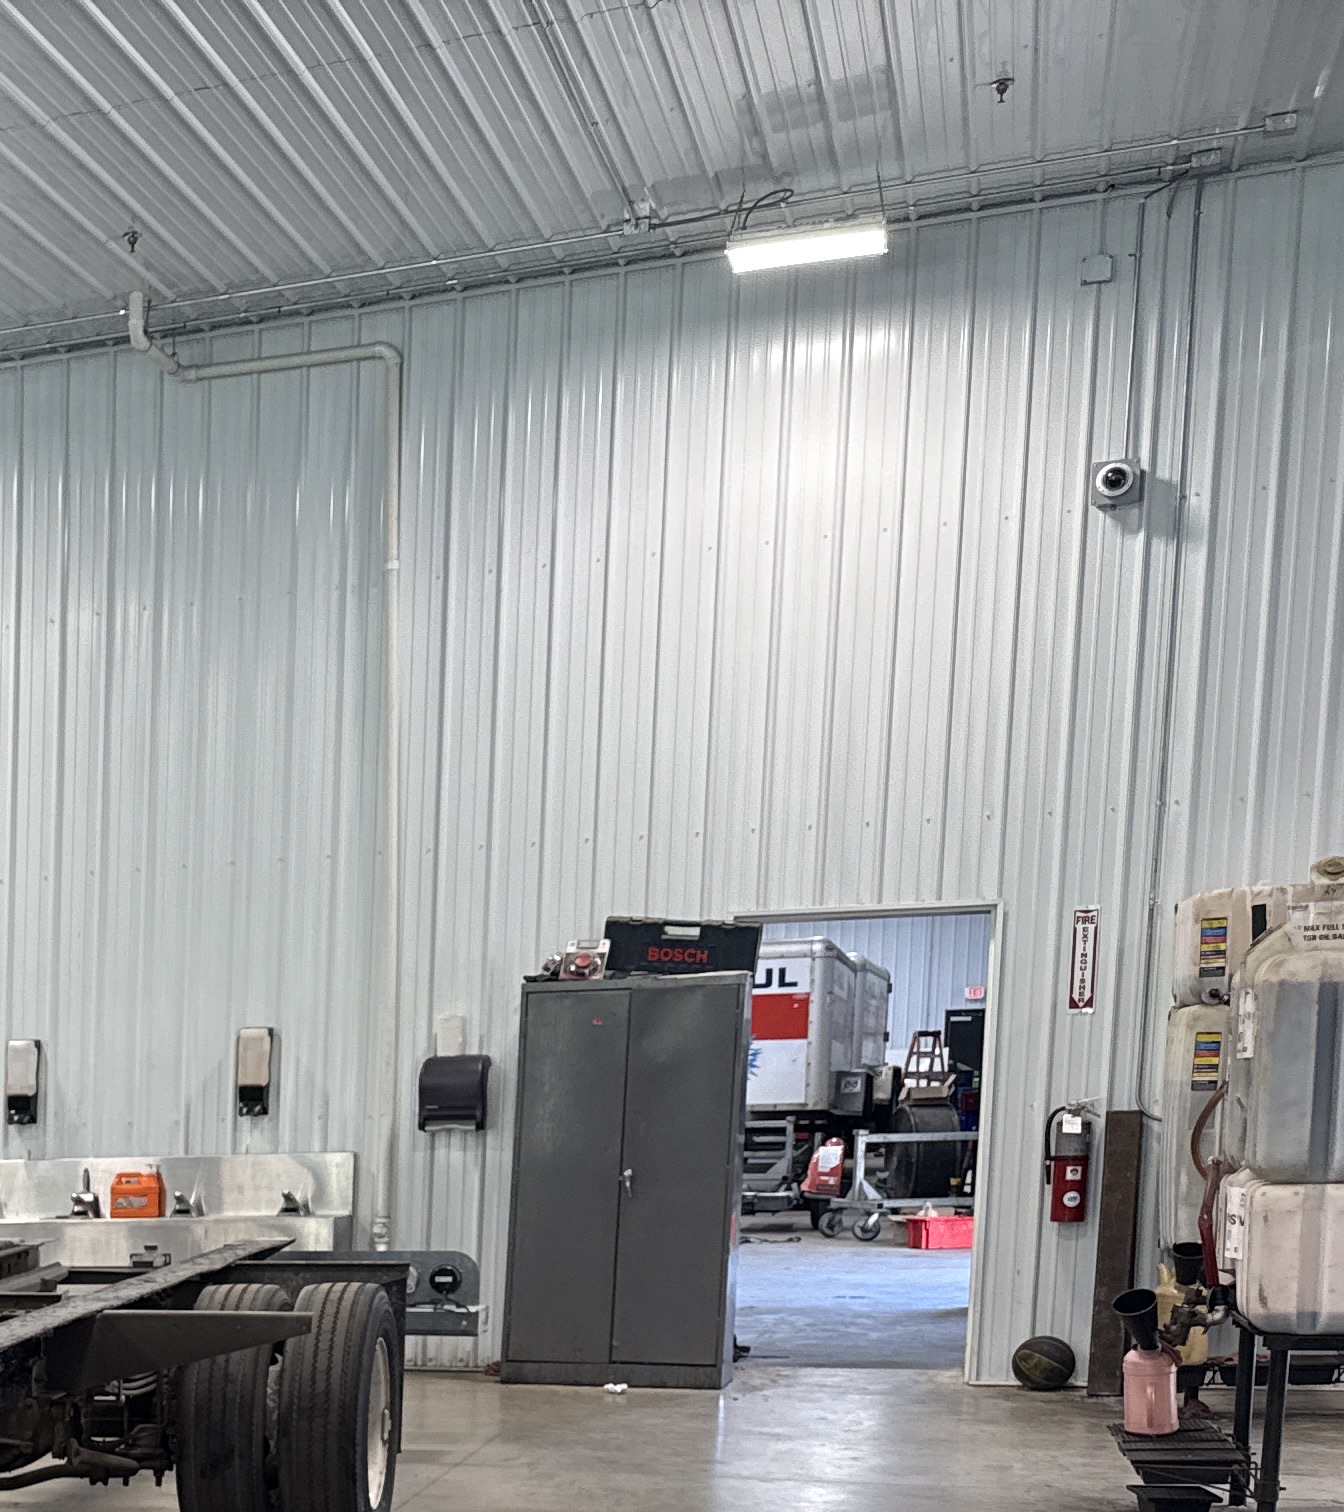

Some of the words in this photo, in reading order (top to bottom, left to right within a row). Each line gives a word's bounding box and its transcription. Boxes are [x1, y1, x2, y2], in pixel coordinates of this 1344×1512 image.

[1075, 915, 1097, 925] FIRE
[647, 945, 709, 964] BOSCH
[1077, 926, 1090, 1004] EXTINGUISHER
